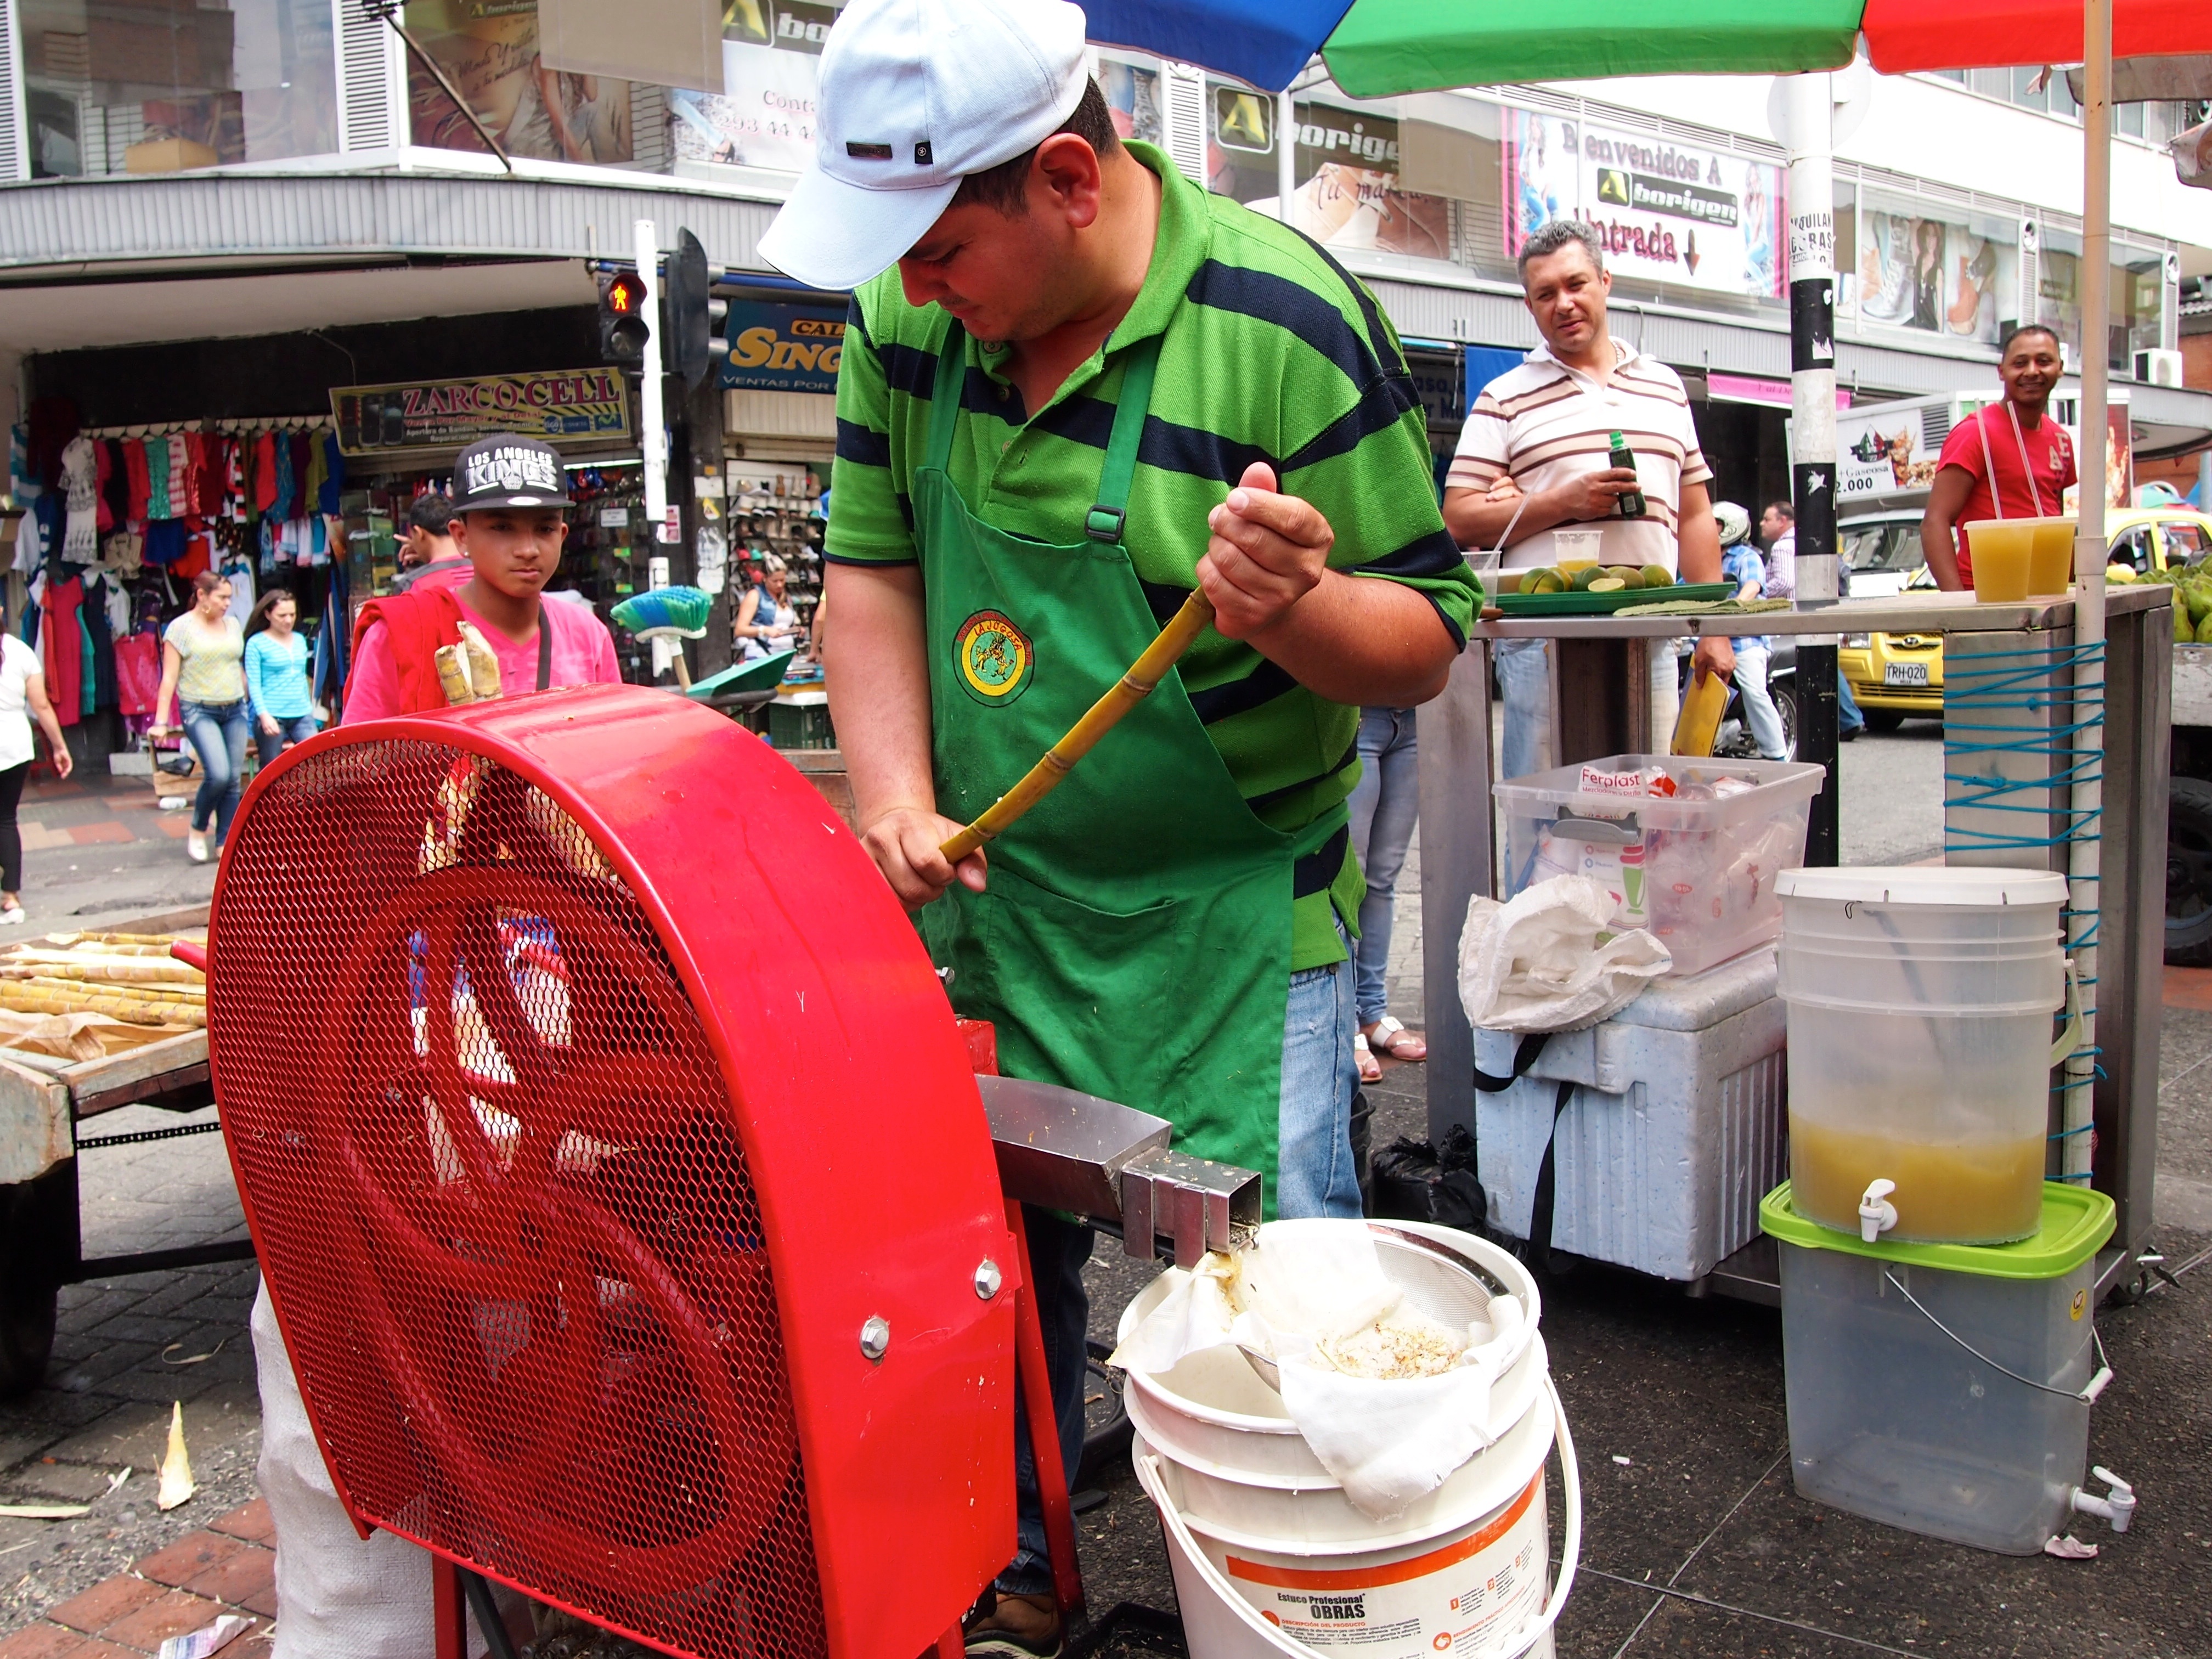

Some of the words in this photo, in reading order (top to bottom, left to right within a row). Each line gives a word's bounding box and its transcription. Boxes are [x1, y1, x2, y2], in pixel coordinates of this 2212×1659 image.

[719, 115, 758, 133] 293
[768, 121, 789, 137] 44
[1561, 123, 1700, 182] Benvenidos
[1707, 155, 1722, 186] A
[795, 323, 846, 336] CAL
[723, 375, 788, 387] VENTAS
[794, 380, 828, 390] POR
[403, 382, 519, 417] ZARCO
[524, 375, 620, 408] CELL
[468, 452, 490, 467] LOS
[494, 447, 553, 466] ANGELES
[466, 459, 557, 490] KINGS
[973, 623, 985, 636] LA
[1582, 769, 1640, 788] Ferplast
[1277, 1593, 1307, 1604] Estuco
[1310, 1604, 1365, 1619] OBRAS
[1282, 1619, 1319, 1628] DESCRIPCIÓN
